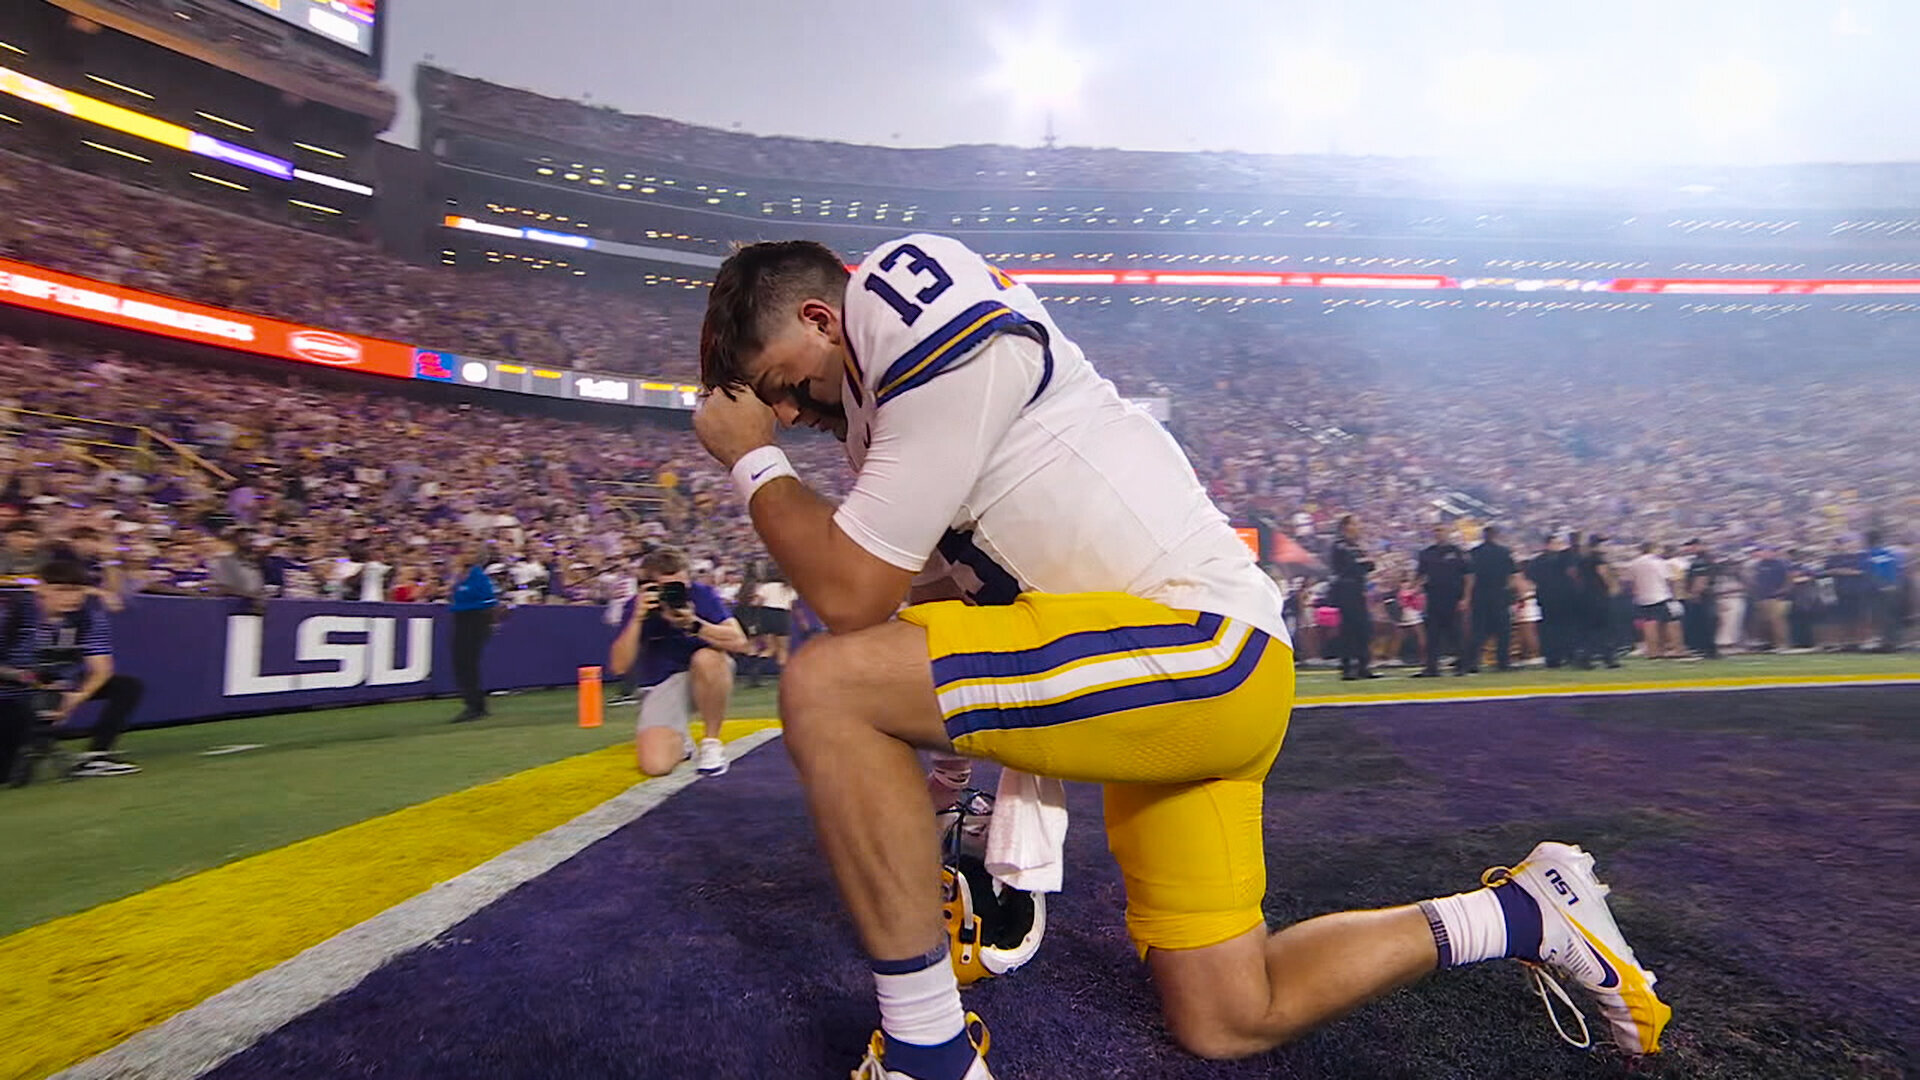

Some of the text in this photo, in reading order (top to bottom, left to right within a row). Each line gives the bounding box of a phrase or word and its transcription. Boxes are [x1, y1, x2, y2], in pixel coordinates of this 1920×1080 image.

[864, 243, 954, 327] 13
[222, 615, 434, 696] LSU
[1545, 868, 1580, 906] LSU
